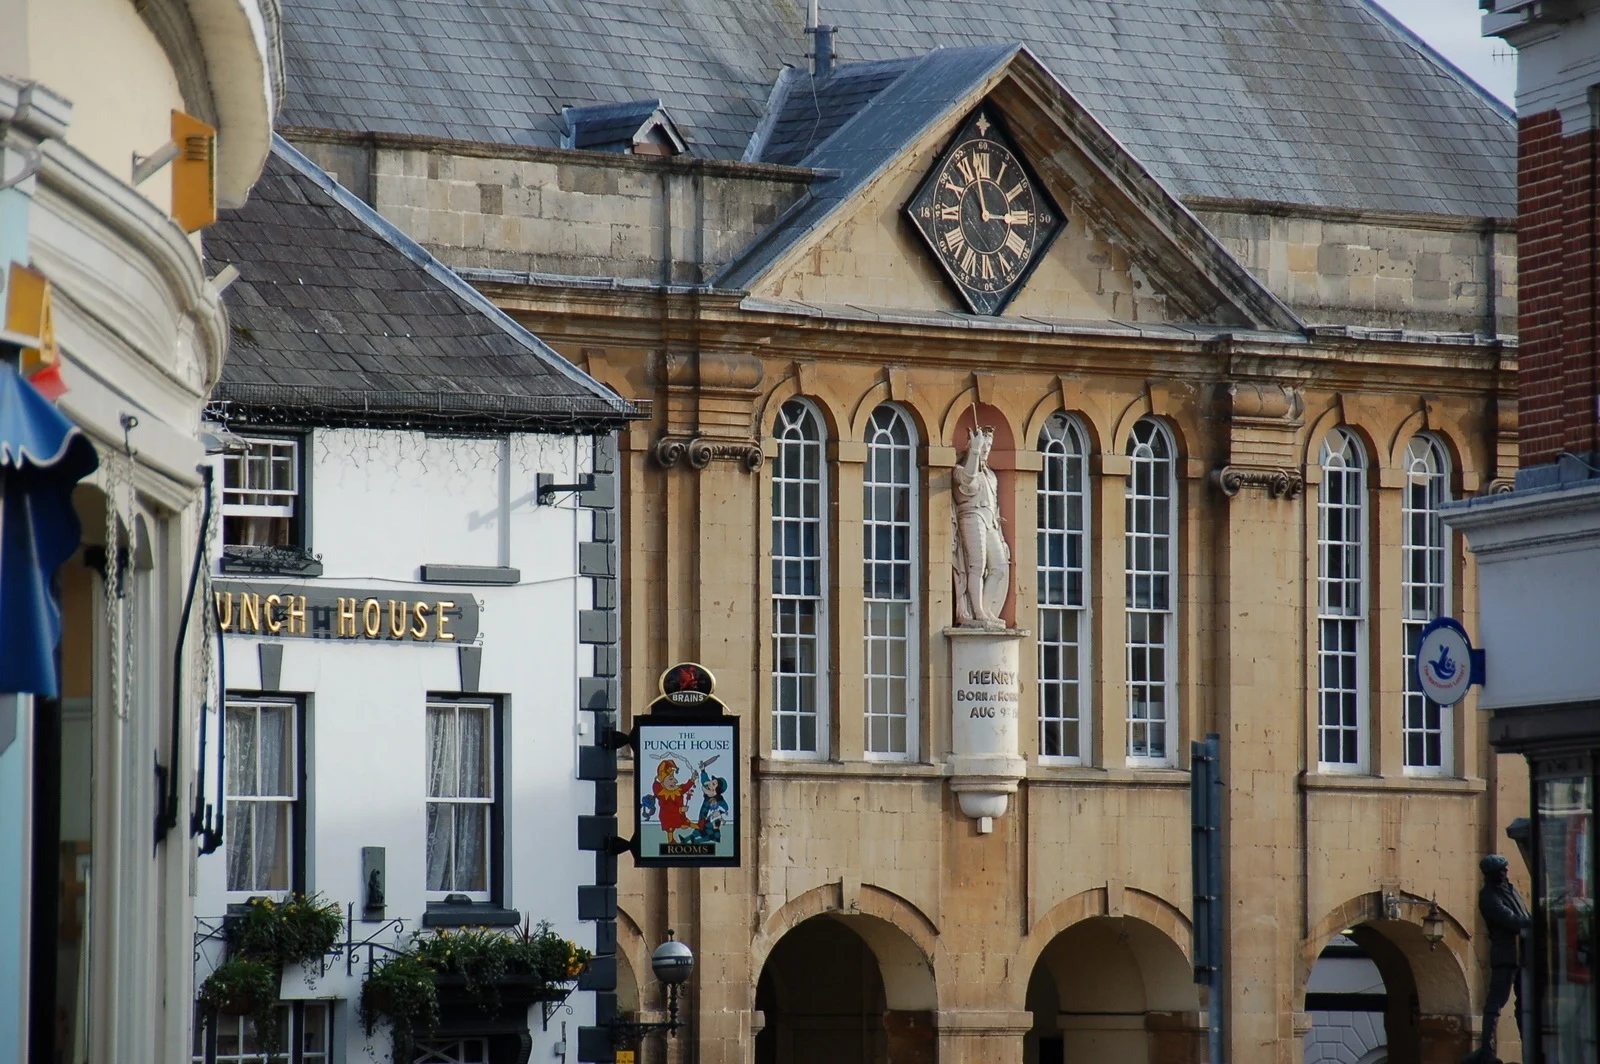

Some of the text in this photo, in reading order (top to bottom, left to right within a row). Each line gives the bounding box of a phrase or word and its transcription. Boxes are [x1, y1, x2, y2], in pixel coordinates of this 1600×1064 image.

[978, 142, 988, 150] 60
[957, 156, 975, 185] XI
[996, 161, 1008, 185] I
[945, 173, 965, 200] X
[1005, 183, 1024, 203] II
[920, 207, 1051, 224] 18 50
[942, 202, 960, 221] IX
[1011, 209, 1029, 225] III
[945, 226, 965, 259] VIII
[960, 246, 977, 277] VII
[982, 254, 995, 279] VI
[998, 251, 1011, 276] V
[337, 597, 455, 640] HOUSE
[968, 669, 1015, 685] HENRY
[1428, 676, 1453, 689] National
[1453, 663, 1466, 686] Lottery
[672, 693, 704, 703] BRAINS
[957, 689, 988, 702] BORN
[989, 694, 997, 702] AT
[970, 706, 995, 719] AUG
[644, 740, 730, 751] PUNCH HOUSE
[667, 845, 709, 854] ROOMS
